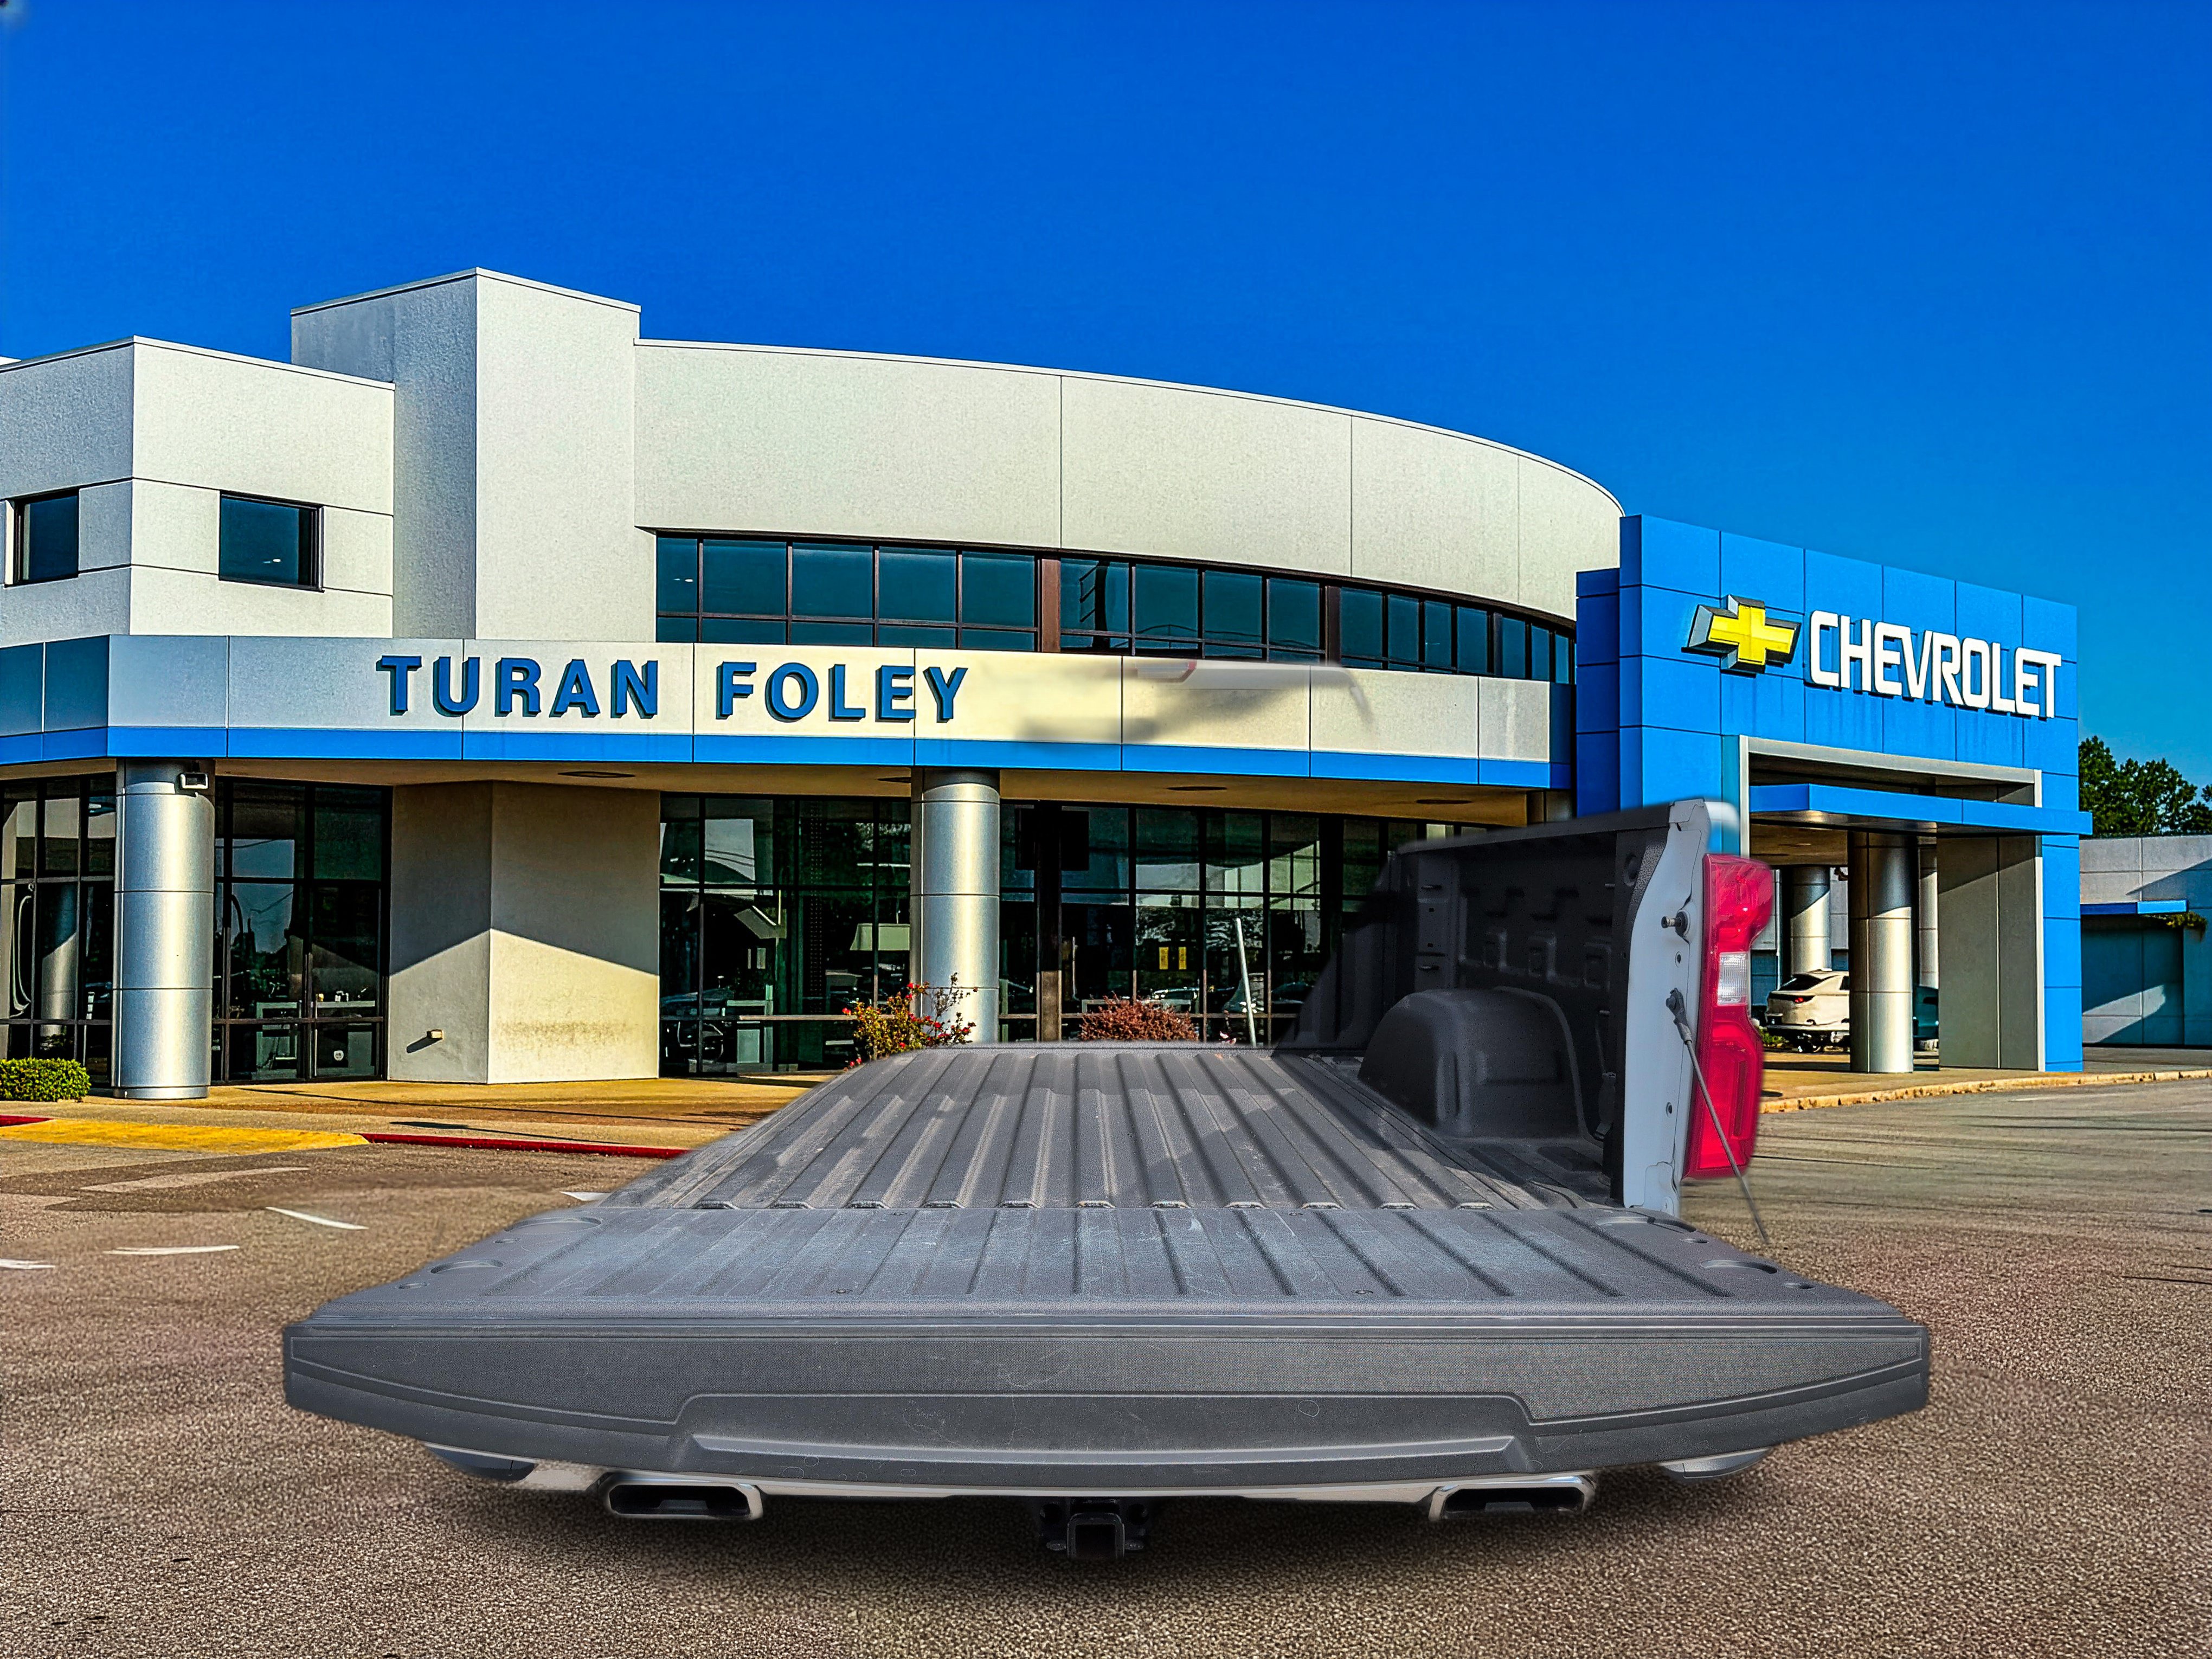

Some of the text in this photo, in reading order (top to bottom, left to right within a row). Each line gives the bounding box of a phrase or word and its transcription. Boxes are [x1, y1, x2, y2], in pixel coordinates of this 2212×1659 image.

[377, 655, 968, 722] TURAN FOLEY
[1810, 610, 2062, 718] CHEVROLET
